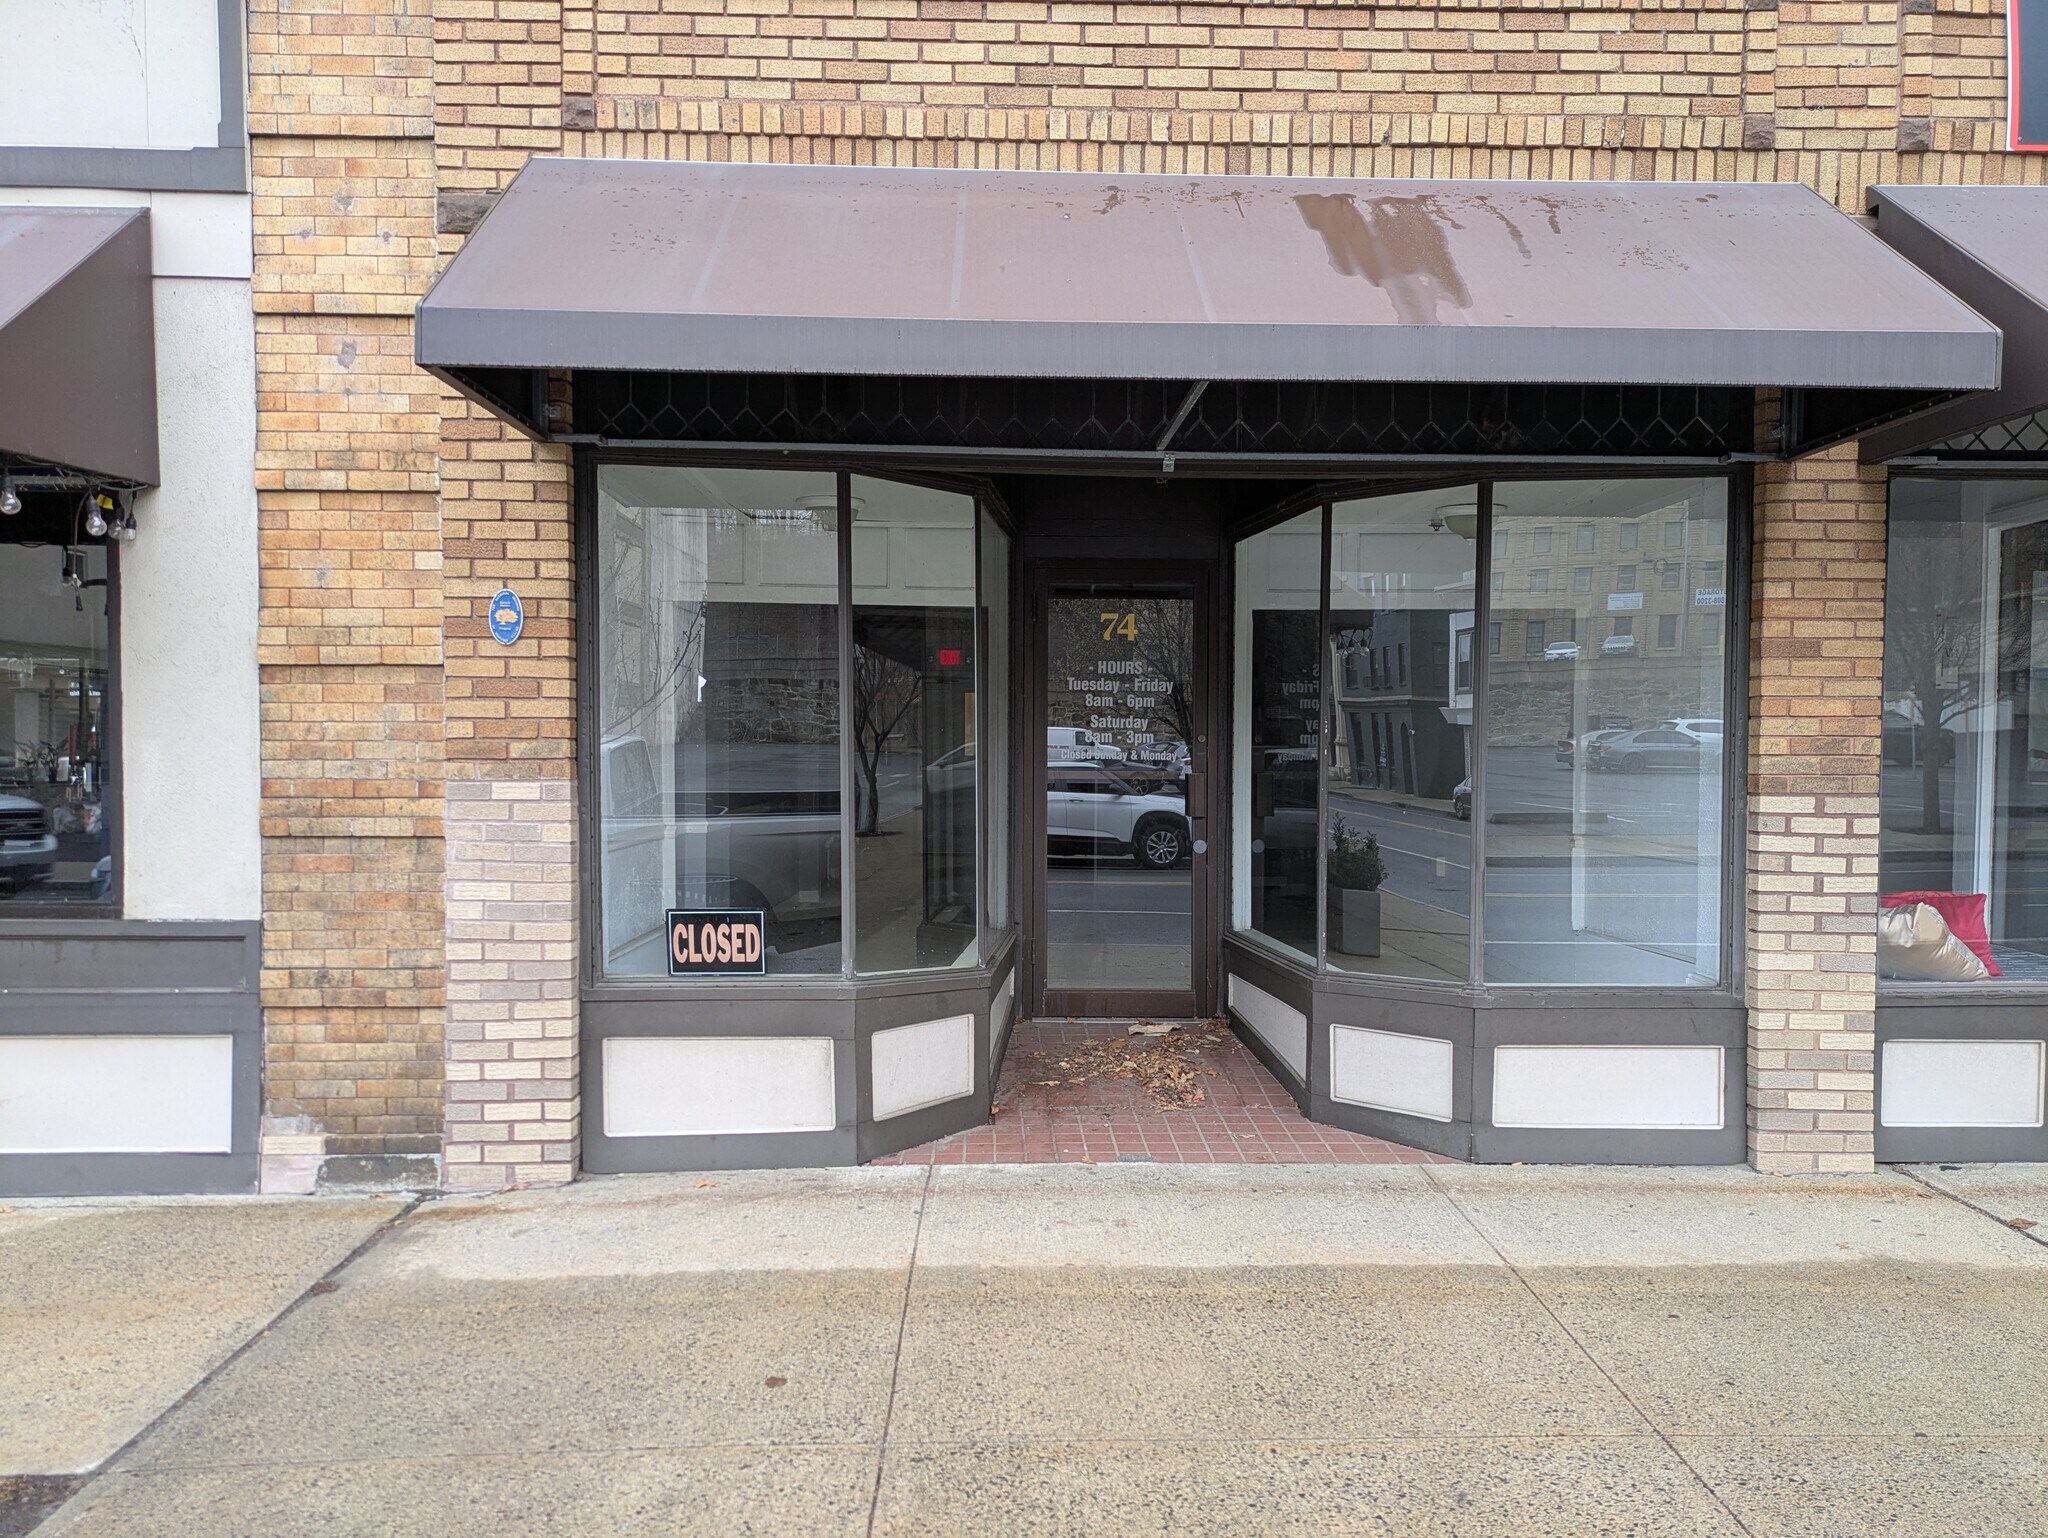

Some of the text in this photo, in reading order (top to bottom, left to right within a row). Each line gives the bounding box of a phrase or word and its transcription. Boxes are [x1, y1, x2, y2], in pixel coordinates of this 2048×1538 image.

[1100, 612, 1139, 642] 74
[939, 649, 960, 665] EXIT
[1097, 660, 1143, 675] HOURS
[1067, 677, 1120, 693] Tuesday
[1134, 678, 1174, 694] Friday
[1085, 694, 1113, 707] 8am
[1127, 694, 1155, 709] 6pm
[1090, 714, 1149, 731] Saturday
[1084, 730, 1113, 743] 8am
[1127, 731, 1155, 746] 3pm
[1061, 749, 1092, 760] Closed
[1131, 750, 1138, 760] &
[1140, 750, 1177, 763] Monday
[672, 922, 761, 963] CLOSED
